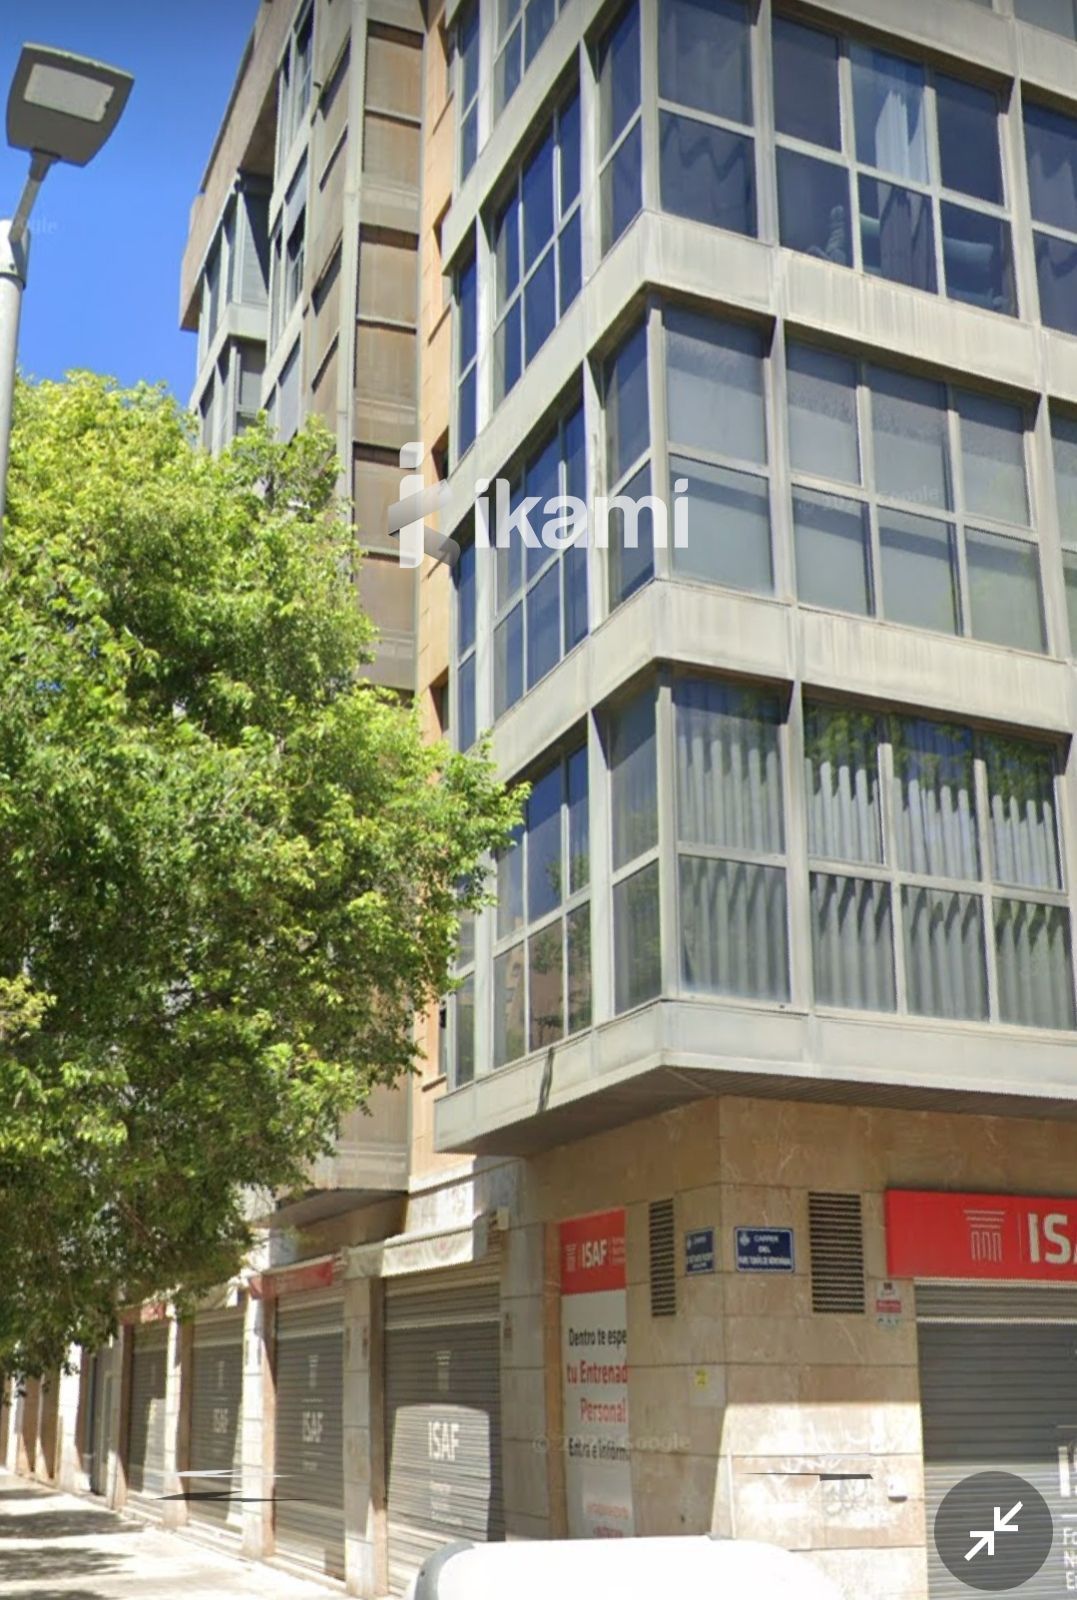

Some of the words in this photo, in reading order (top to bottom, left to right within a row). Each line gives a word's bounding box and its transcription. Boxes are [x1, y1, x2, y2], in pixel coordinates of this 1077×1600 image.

[1028, 1212, 1077, 1264] IS
[582, 1239, 608, 1269] ISAF
[568, 1328, 595, 1346] Dentro
[597, 1328, 606, 1345] te
[608, 1329, 627, 1350] espe
[567, 1363, 577, 1384] tu
[580, 1360, 628, 1384] Entrenad
[580, 1397, 627, 1424] Personal
[428, 1421, 460, 1461] ISAF
